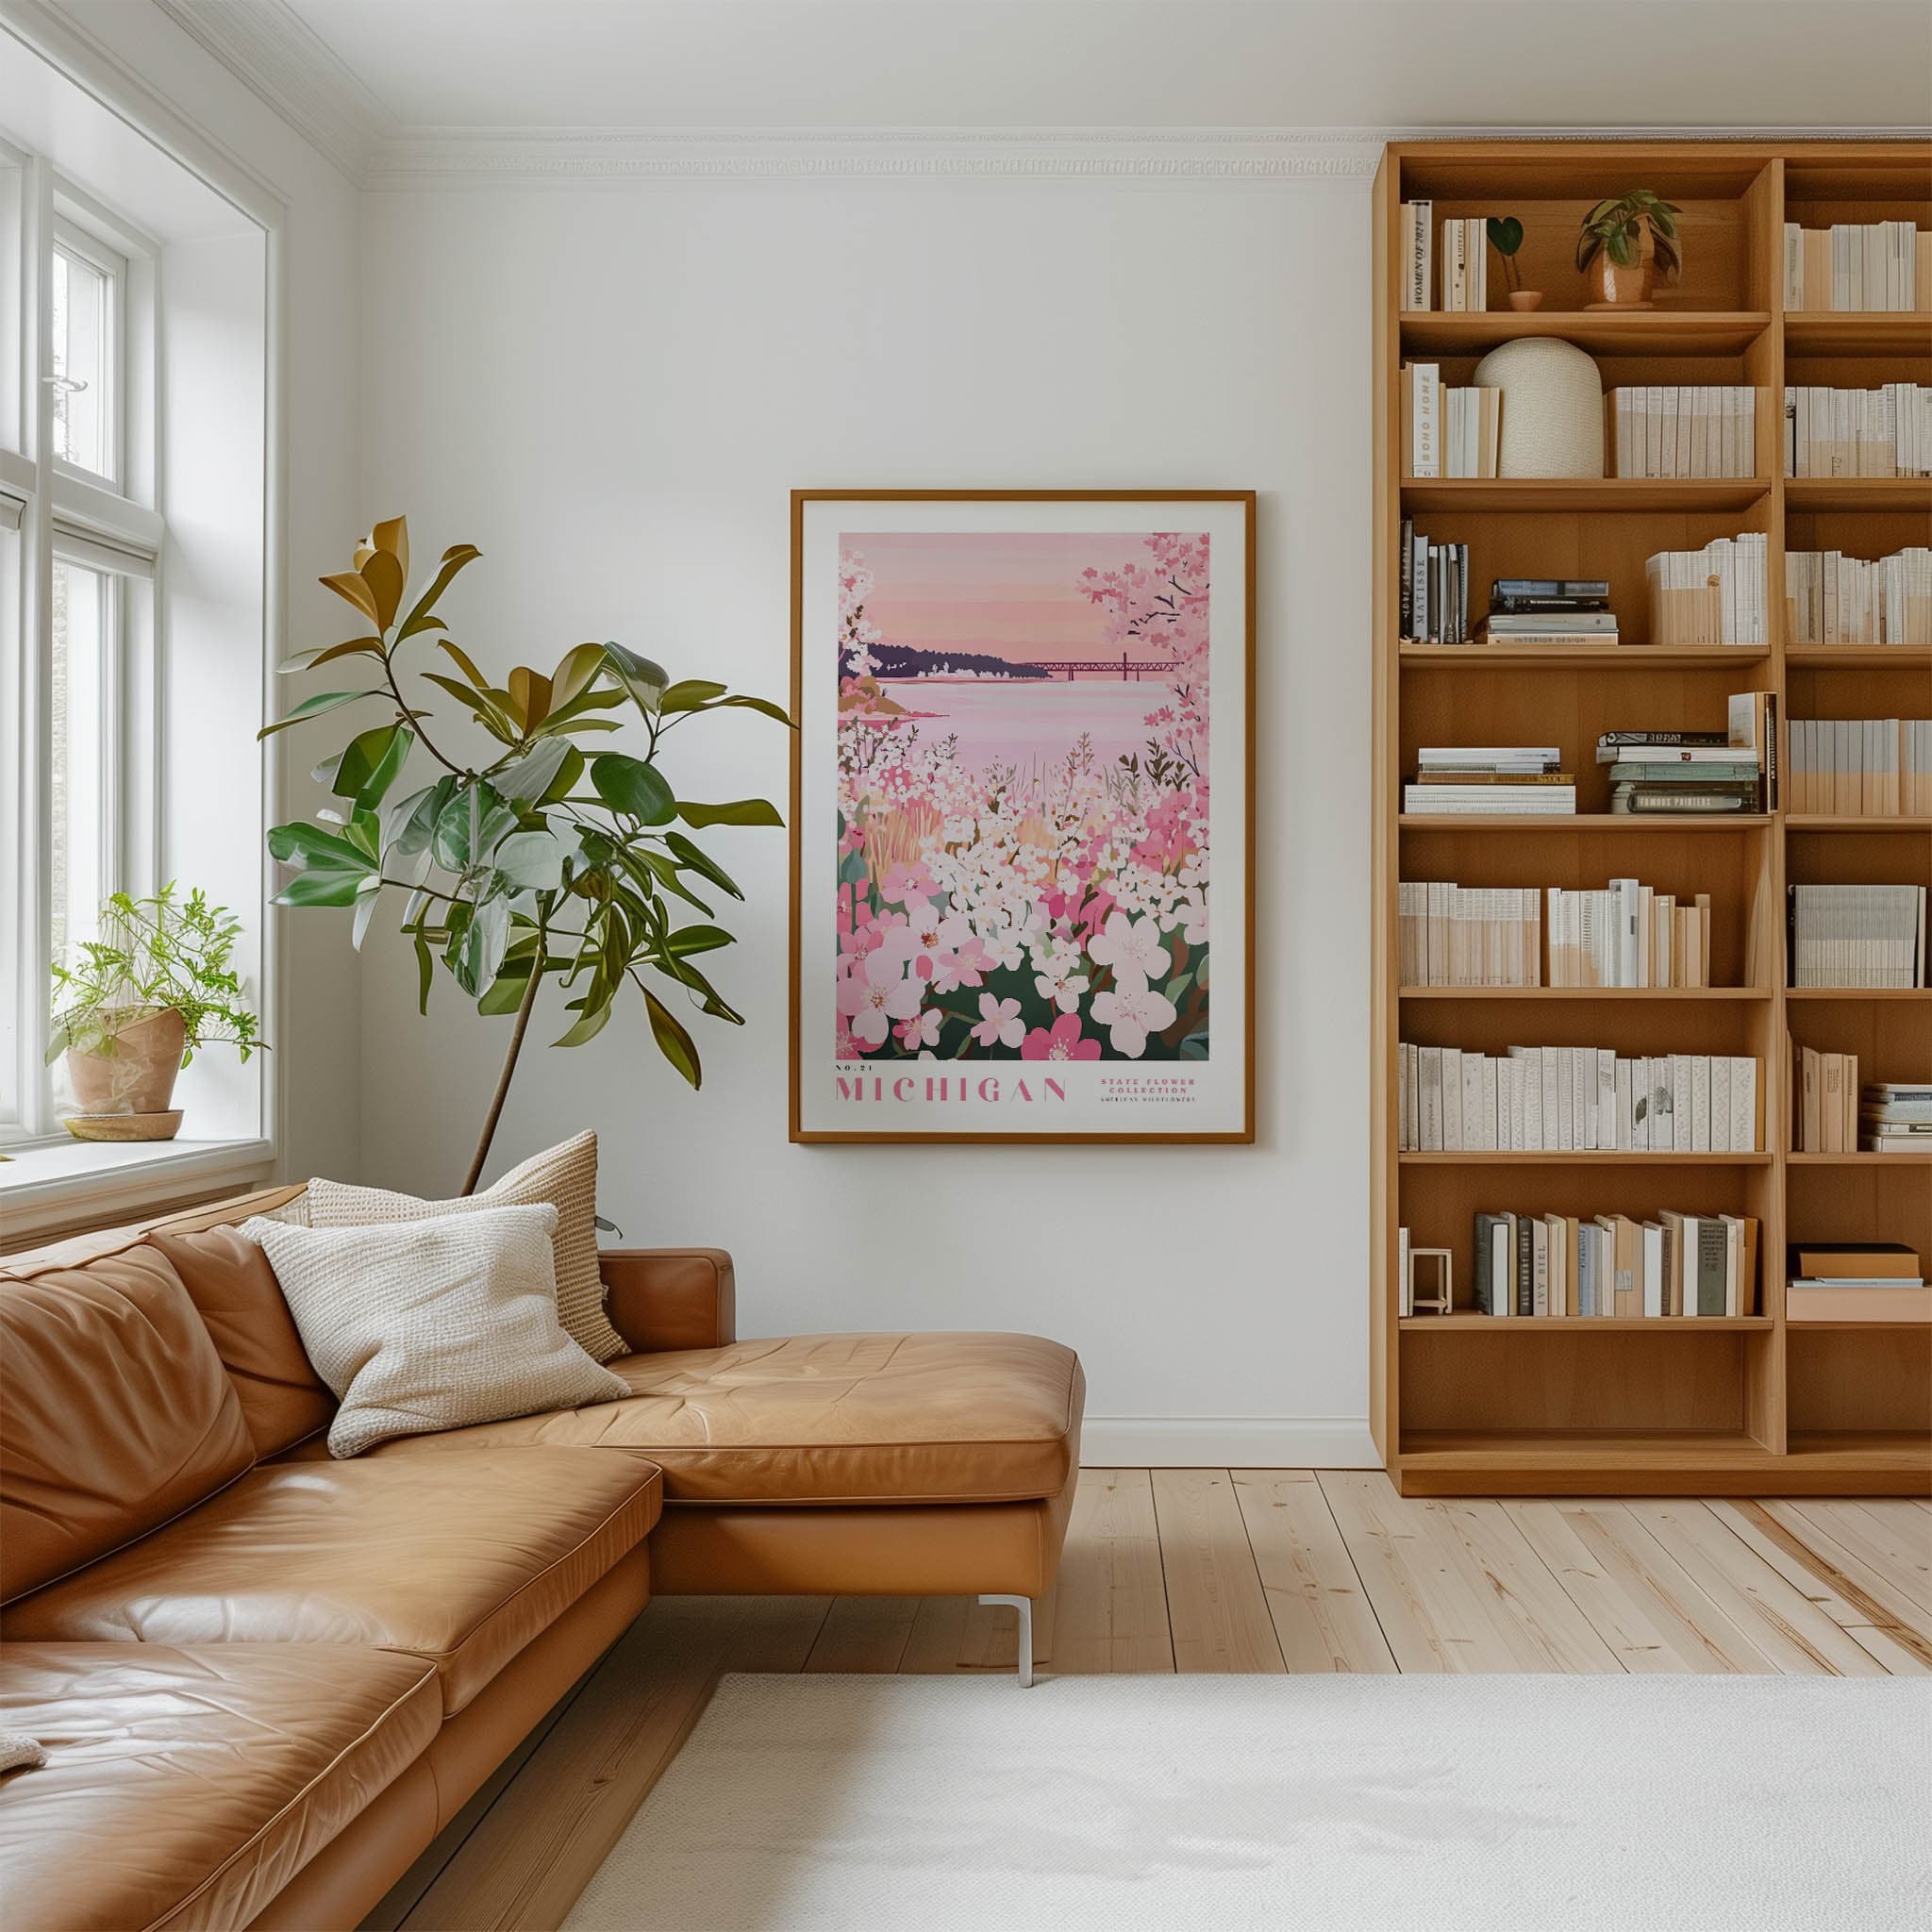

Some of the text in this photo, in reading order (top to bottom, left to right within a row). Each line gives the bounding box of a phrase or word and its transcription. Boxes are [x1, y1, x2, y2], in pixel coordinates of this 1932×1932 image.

[1414, 245, 1424, 260] OF
[1414, 263, 1424, 306] WOMEN
[1422, 375, 1430, 415] HOME
[1422, 422, 1430, 462] BOHO
[1416, 558, 1425, 625] MATISSE
[1639, 796, 1711, 808] FAMOUS PAINTERS
[835, 1076, 1067, 1102] MICHIGAN
[1522, 1230, 1530, 1307] ALL ABOUT CATS
[1537, 1244, 1546, 1306] IVY BIEL
